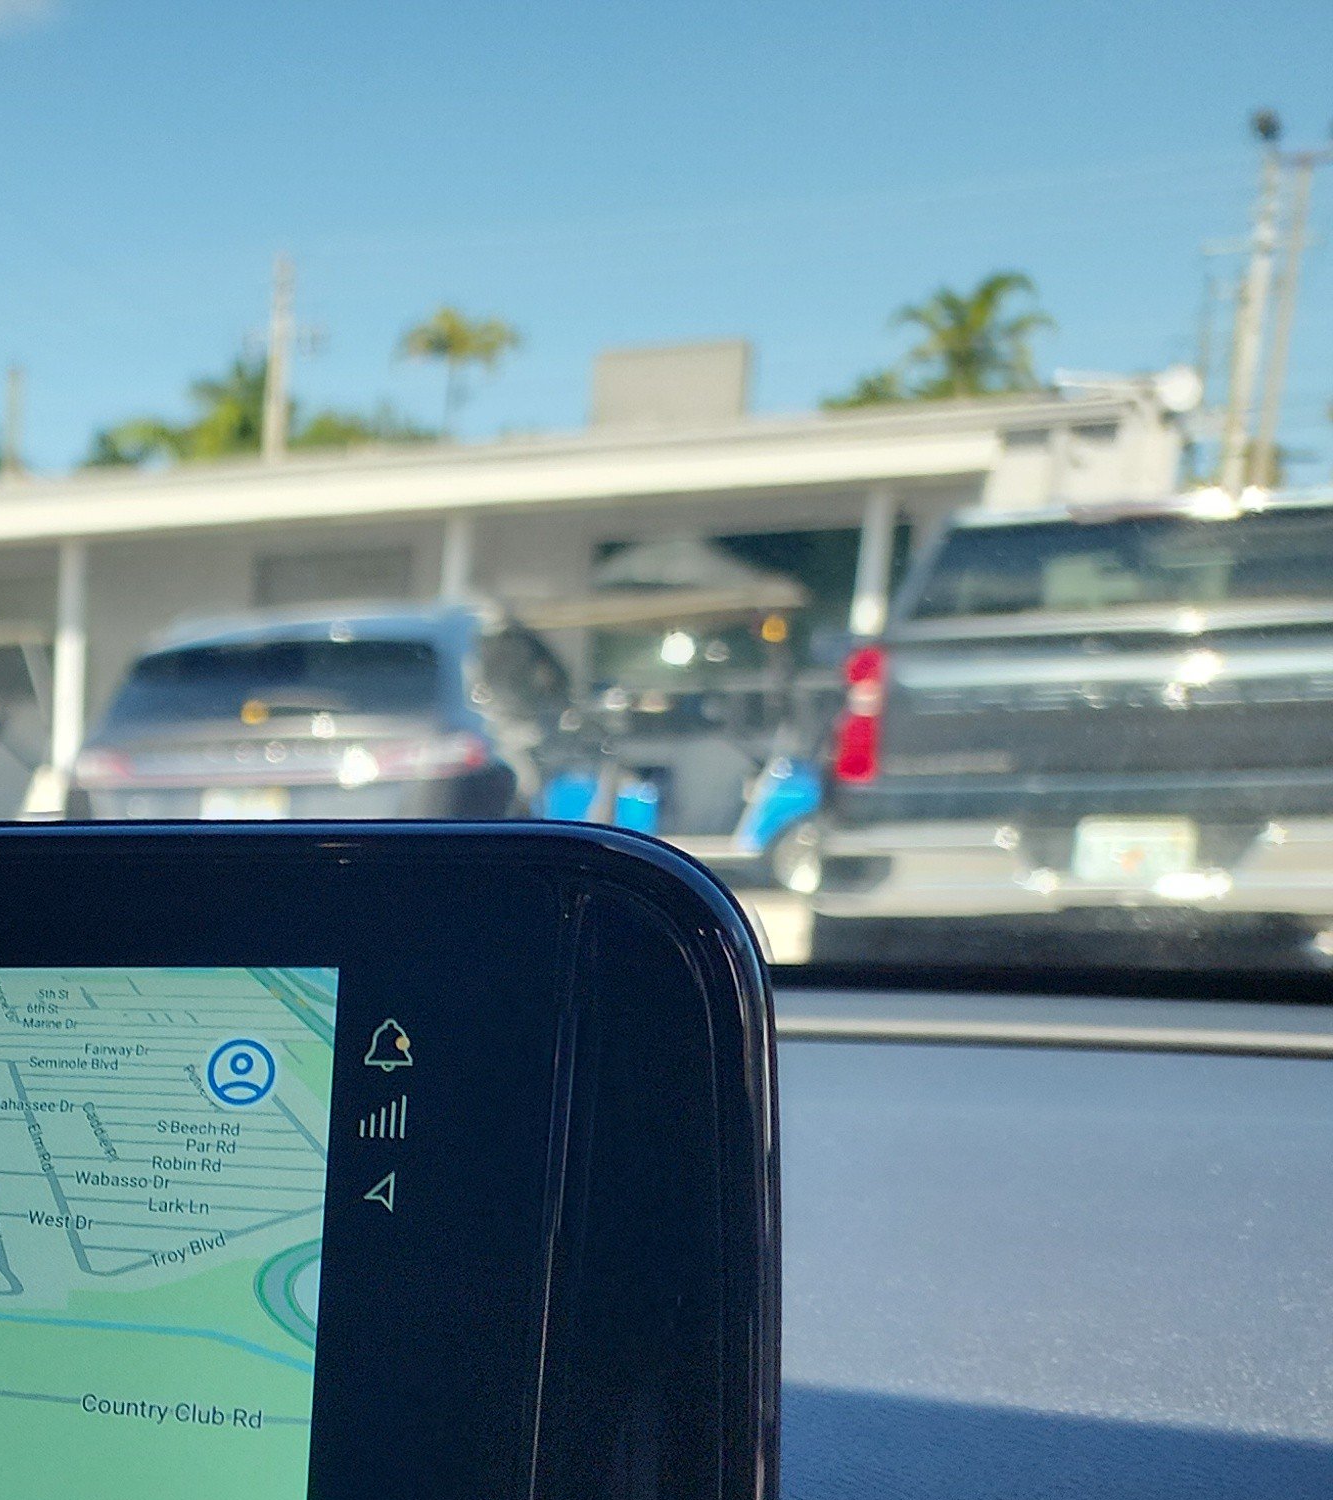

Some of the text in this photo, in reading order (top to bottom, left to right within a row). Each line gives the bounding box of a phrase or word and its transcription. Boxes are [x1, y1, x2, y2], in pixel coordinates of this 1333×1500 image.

[65, 1018, 77, 1029] Dr
[85, 1044, 149, 1056] Fairway Dr
[29, 1056, 119, 1071] Seminole Blvd
[60, 1100, 75, 1113] Dr
[28, 1122, 49, 1150] Elm
[156, 1119, 240, 1137] S Beech Rd
[186, 1138, 237, 1155] Par Rd
[151, 1156, 222, 1173] Robin Rd
[75, 1171, 170, 1189] Wabasso Dr
[148, 1197, 209, 1214] Lark Ln
[28, 1210, 94, 1231] West Dr
[151, 1231, 226, 1268] Troy Blvd
[81, 1393, 263, 1430] Country Club Rd
